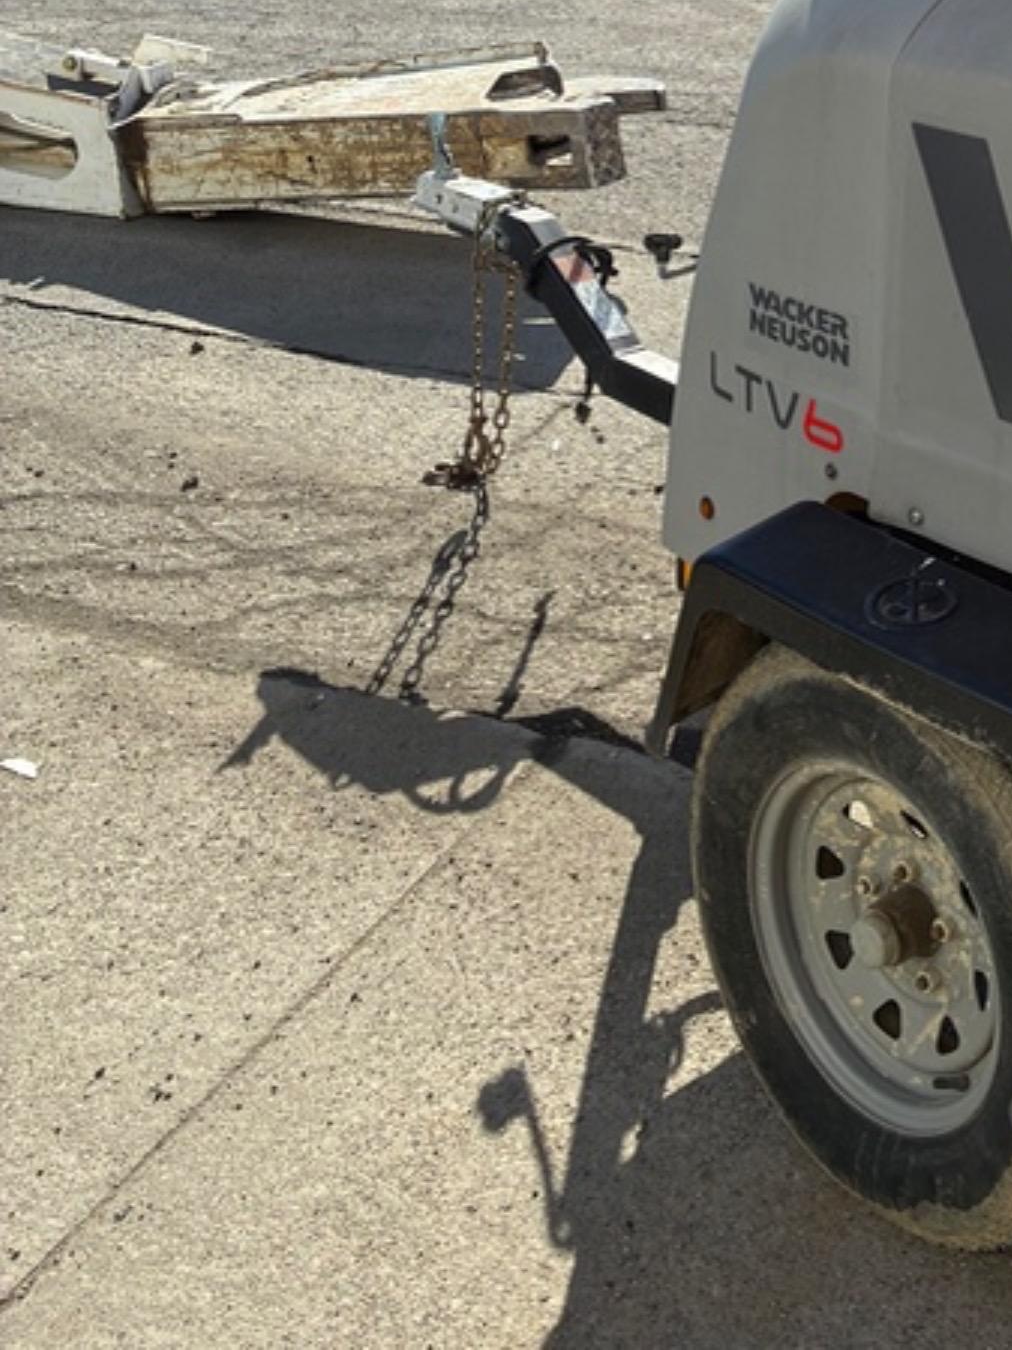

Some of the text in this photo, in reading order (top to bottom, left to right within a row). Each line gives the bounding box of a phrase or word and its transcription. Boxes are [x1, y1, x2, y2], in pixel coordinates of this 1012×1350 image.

[748, 280, 850, 340] WACKER
[749, 307, 850, 367] NEUSON
[710, 350, 844, 454] LTV6
